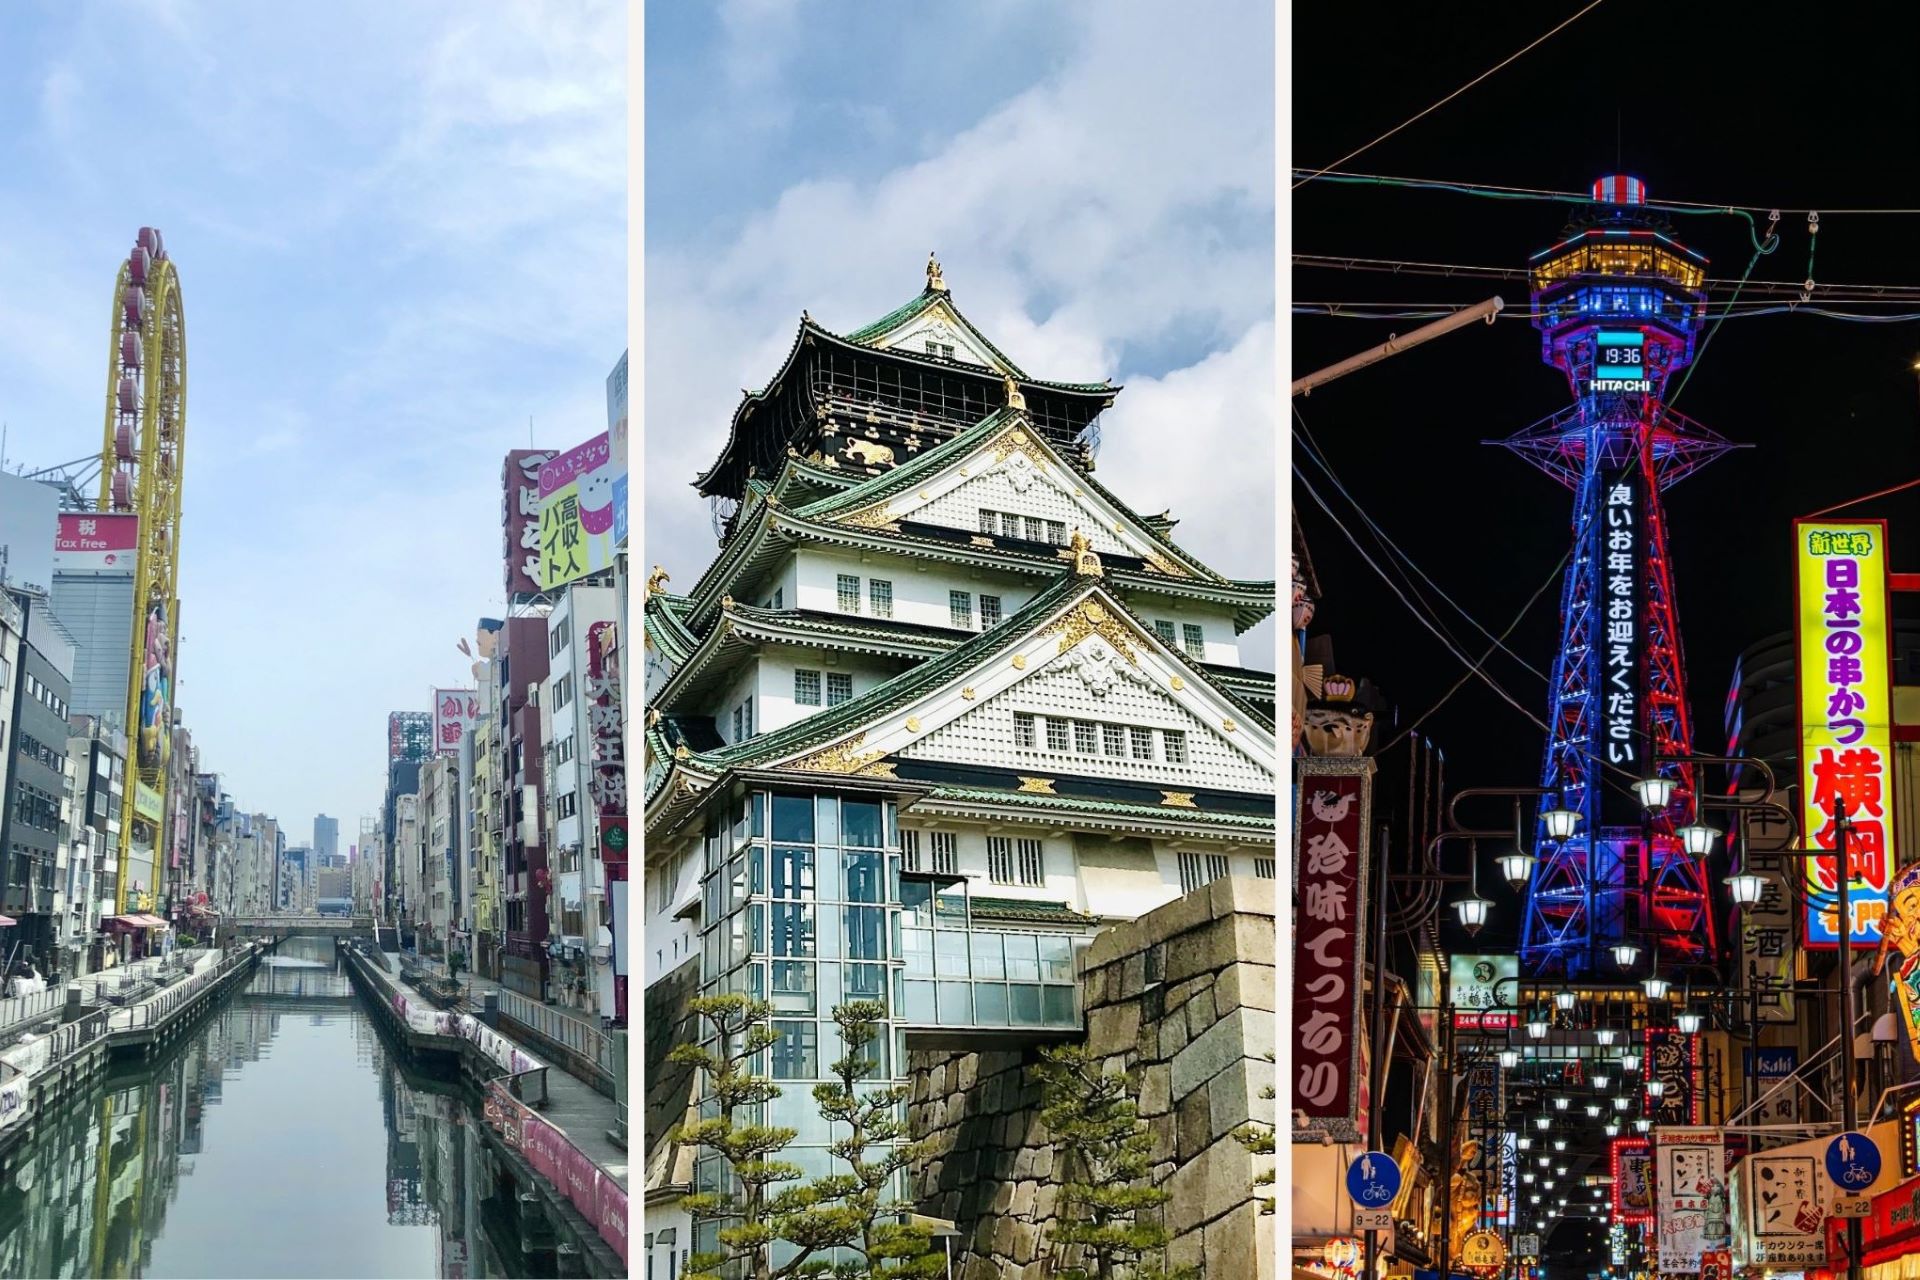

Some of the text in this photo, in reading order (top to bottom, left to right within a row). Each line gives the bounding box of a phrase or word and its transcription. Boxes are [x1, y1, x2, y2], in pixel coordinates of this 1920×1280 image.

[1605, 348, 1641, 364] 19:36
[1590, 379, 1651, 392] HITACHI
[56, 538, 108, 549] Tax Free
[543, 503, 564, 584] バイト
[560, 493, 581, 578] 高収入
[1810, 532, 1872, 556] 新世界
[1607, 483, 1635, 764] 良いお年をお迎えください
[1824, 558, 1865, 745] 日本一の串かつ
[585, 670, 627, 809] 大阪王将
[1813, 747, 1887, 892] 横綱
[1820, 900, 1888, 935] 名門
[1298, 832, 1350, 1107] 珍味てっちり
[1755, 1241, 1825, 1250] 1F カウンター席
[1755, 1252, 1825, 1263] 2F 座敷あります
